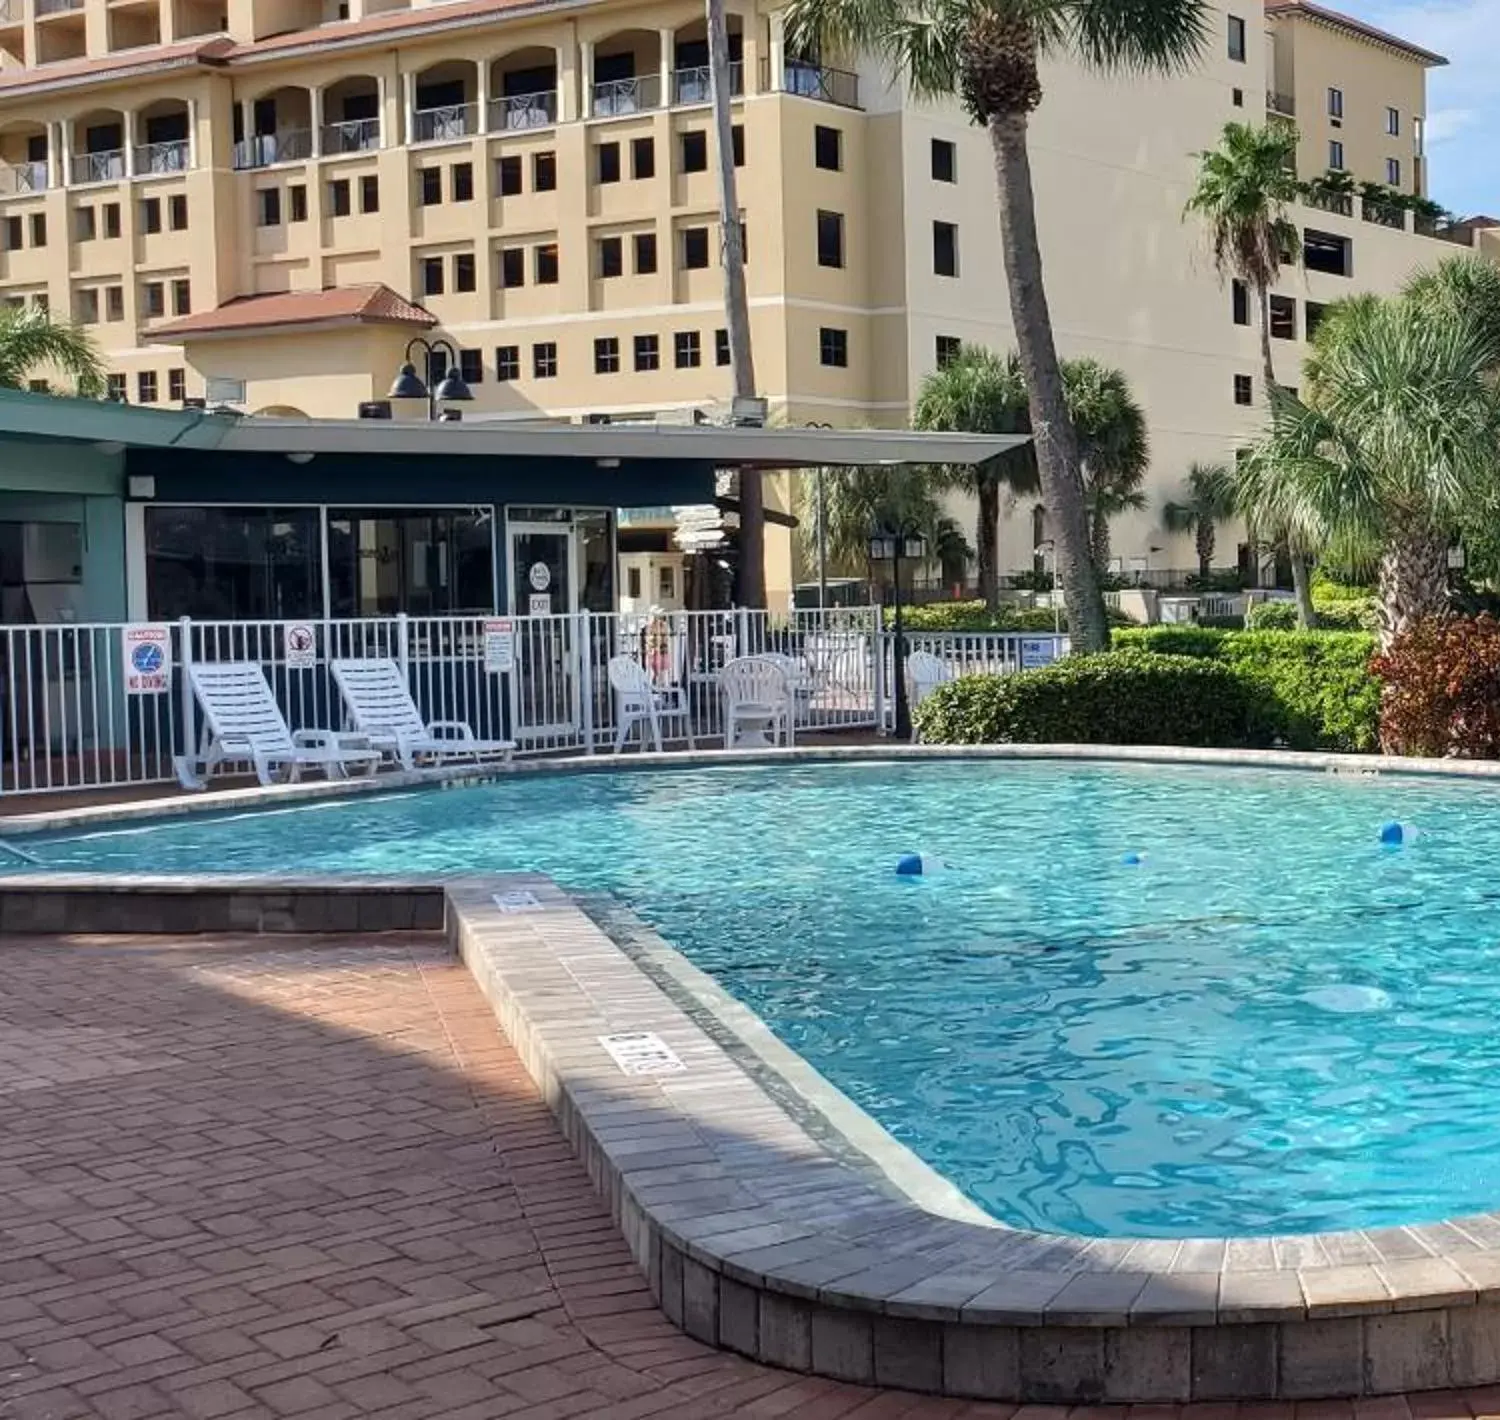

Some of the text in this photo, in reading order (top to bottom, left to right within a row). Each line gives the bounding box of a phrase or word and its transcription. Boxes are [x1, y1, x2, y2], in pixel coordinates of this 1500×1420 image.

[532, 600, 549, 611] EXIT
[129, 674, 169, 689] NO DIVING
